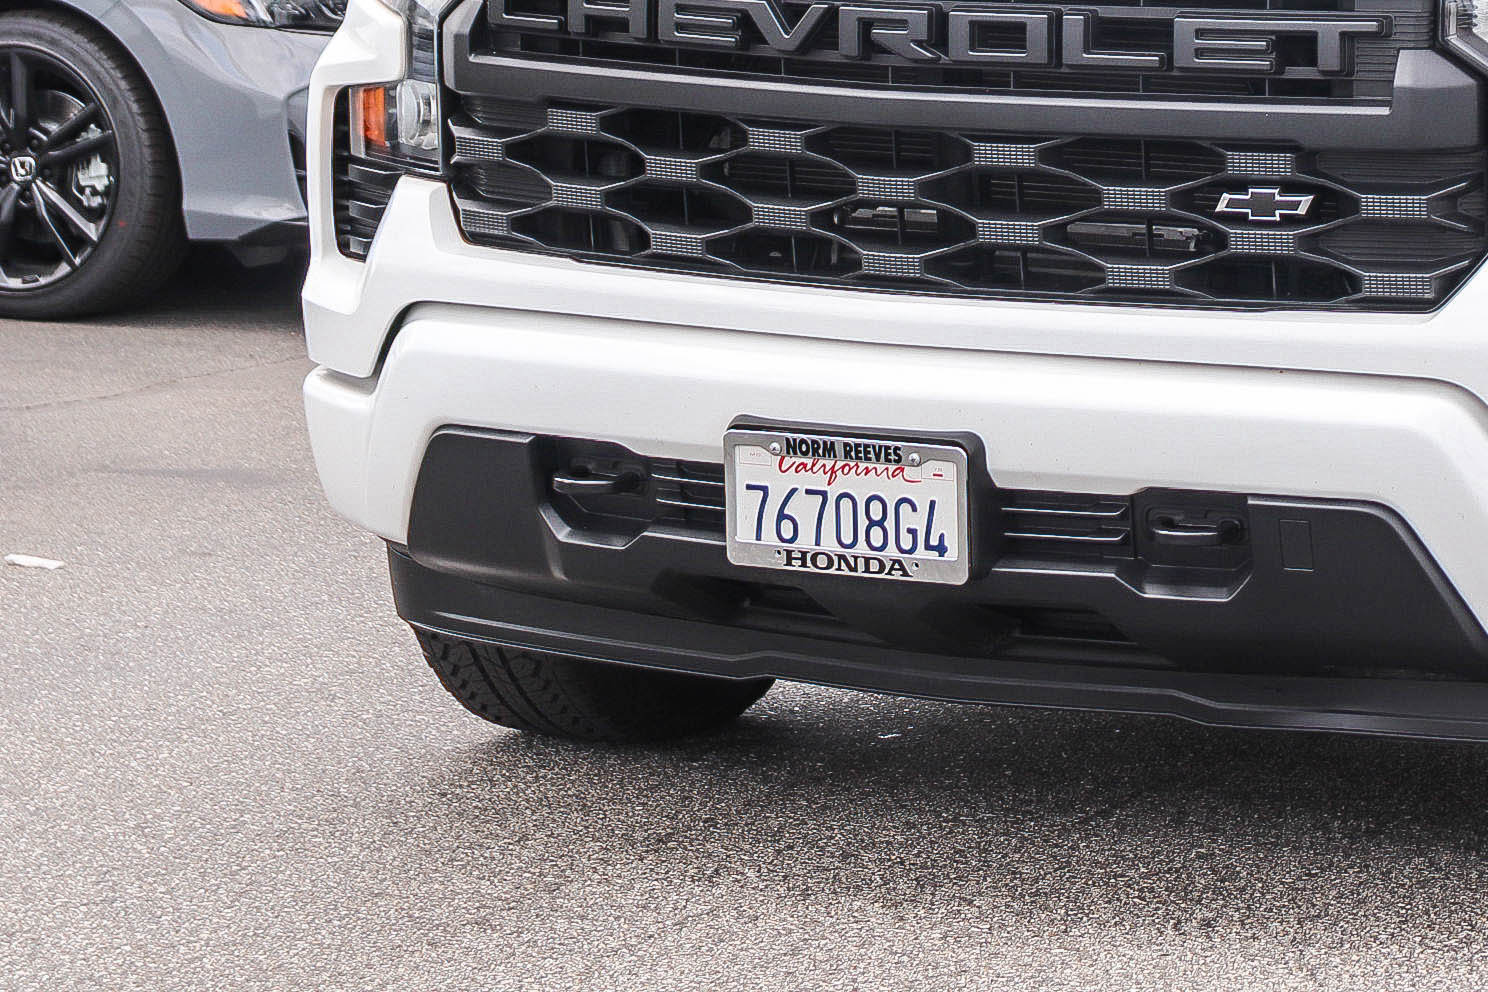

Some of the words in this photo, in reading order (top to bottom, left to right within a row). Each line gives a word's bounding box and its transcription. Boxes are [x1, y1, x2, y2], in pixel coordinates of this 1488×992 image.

[784, 435, 837, 460] NORM
[842, 441, 904, 465] REEVES
[776, 454, 922, 486] California
[744, 482, 950, 559] 76708G4
[782, 548, 914, 578] HONDA
